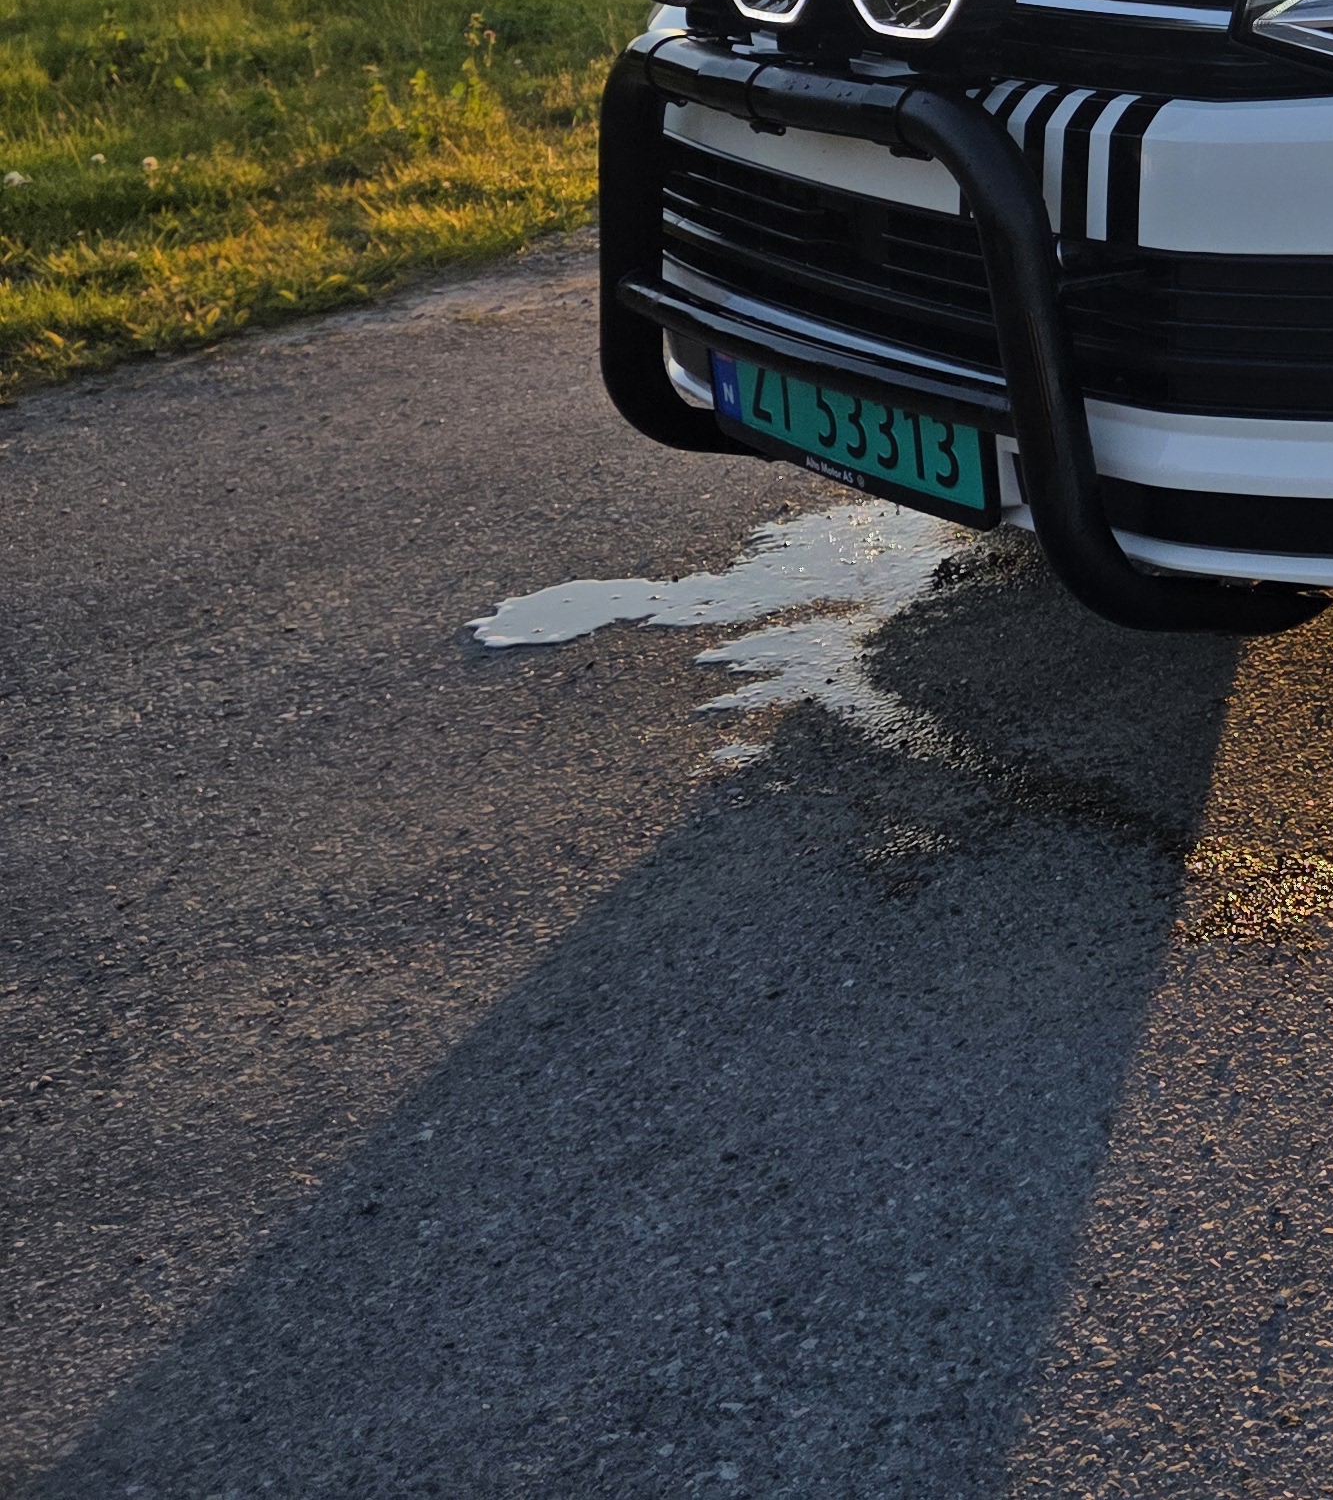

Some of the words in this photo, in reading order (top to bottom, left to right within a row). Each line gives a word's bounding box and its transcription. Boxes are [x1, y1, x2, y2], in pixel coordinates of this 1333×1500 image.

[723, 381, 735, 406] N
[815, 387, 960, 489] 53313
[843, 470, 854, 484] AS
